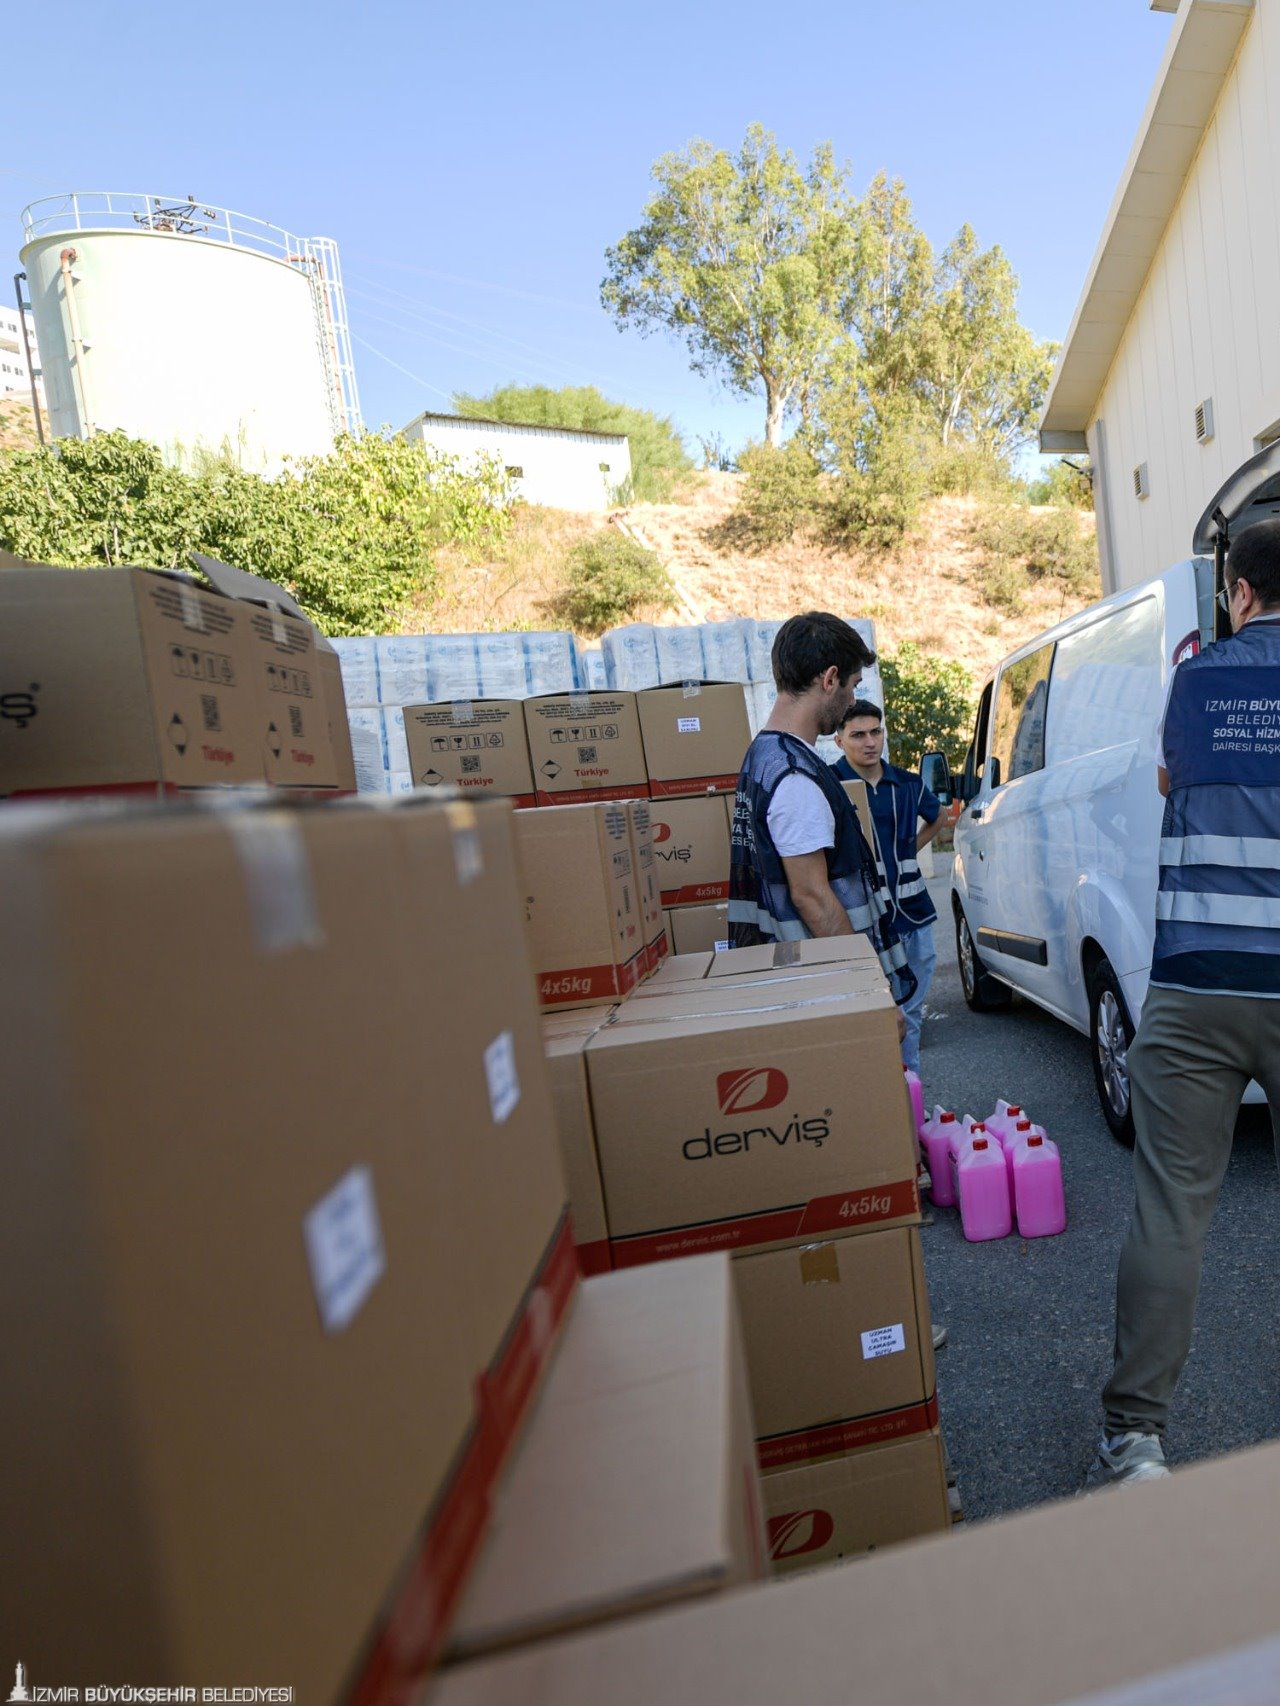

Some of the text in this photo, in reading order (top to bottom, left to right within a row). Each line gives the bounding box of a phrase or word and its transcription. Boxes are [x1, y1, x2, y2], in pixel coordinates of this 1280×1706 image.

[1213, 728, 1253, 738] SOSYAL
[573, 768, 610, 777] Türkiye
[456, 777, 494, 786] Türkiye
[696, 886, 722, 898] 4x5kg
[541, 975, 592, 995] 4x5kg
[682, 1108, 832, 1161] derviş
[838, 1195, 892, 1219] 4x5kg
